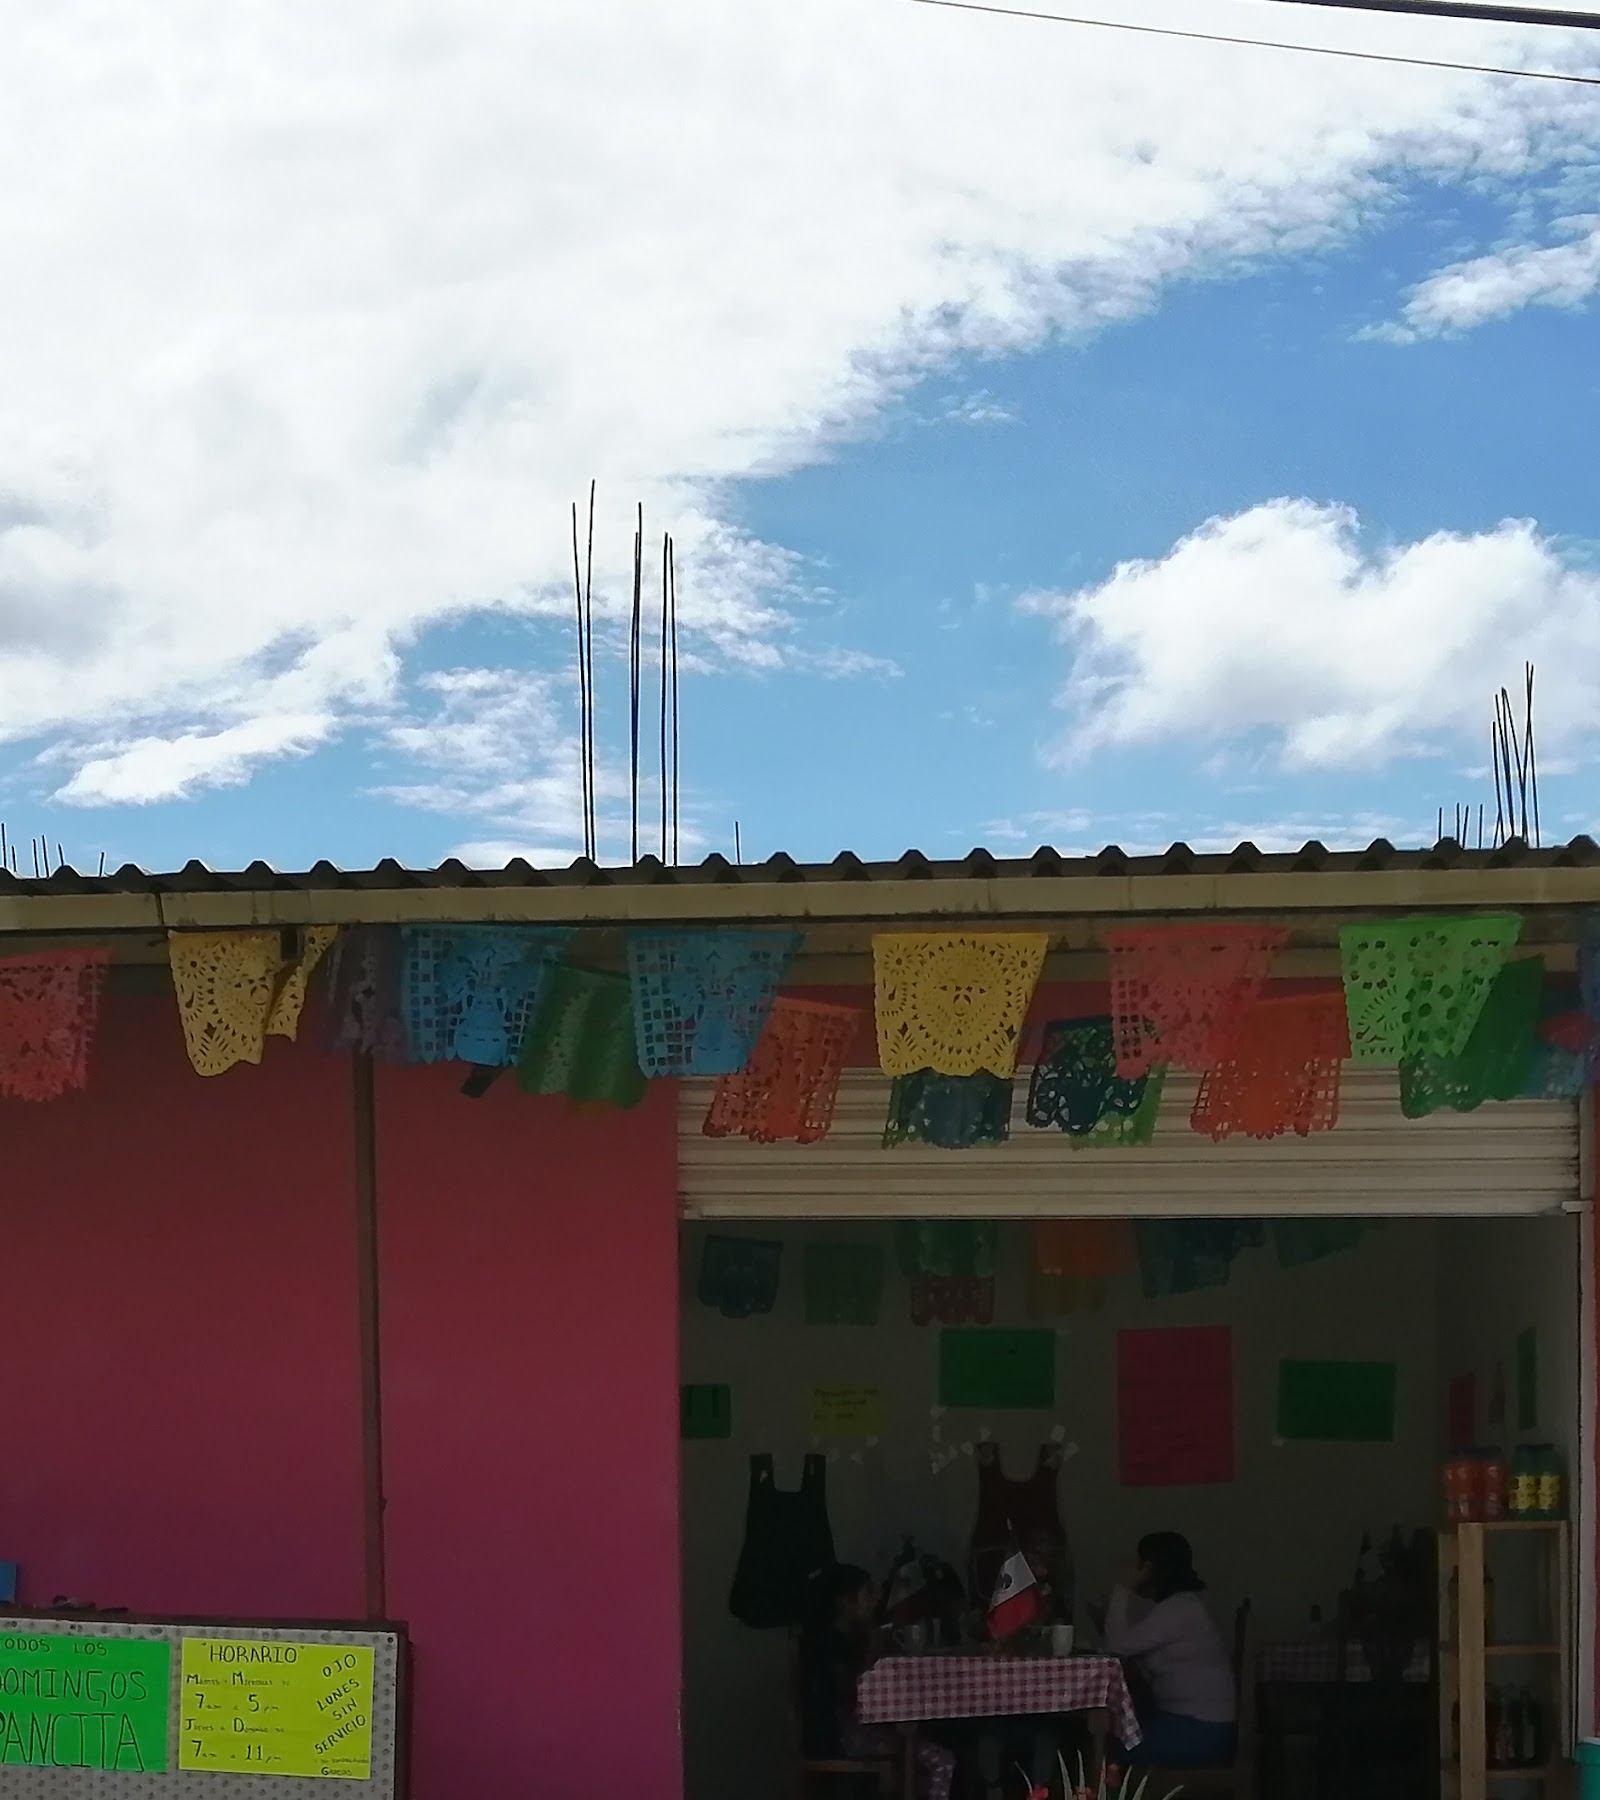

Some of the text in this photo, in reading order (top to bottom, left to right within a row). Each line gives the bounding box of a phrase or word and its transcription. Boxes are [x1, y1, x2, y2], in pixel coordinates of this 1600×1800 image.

[72, 1641, 108, 1657] LOS
[321, 1653, 357, 1678] OJO
[316, 1677, 361, 1712] LUNES
[331, 1697, 358, 1721] SIN
[313, 1713, 367, 1755] SERVICIO
